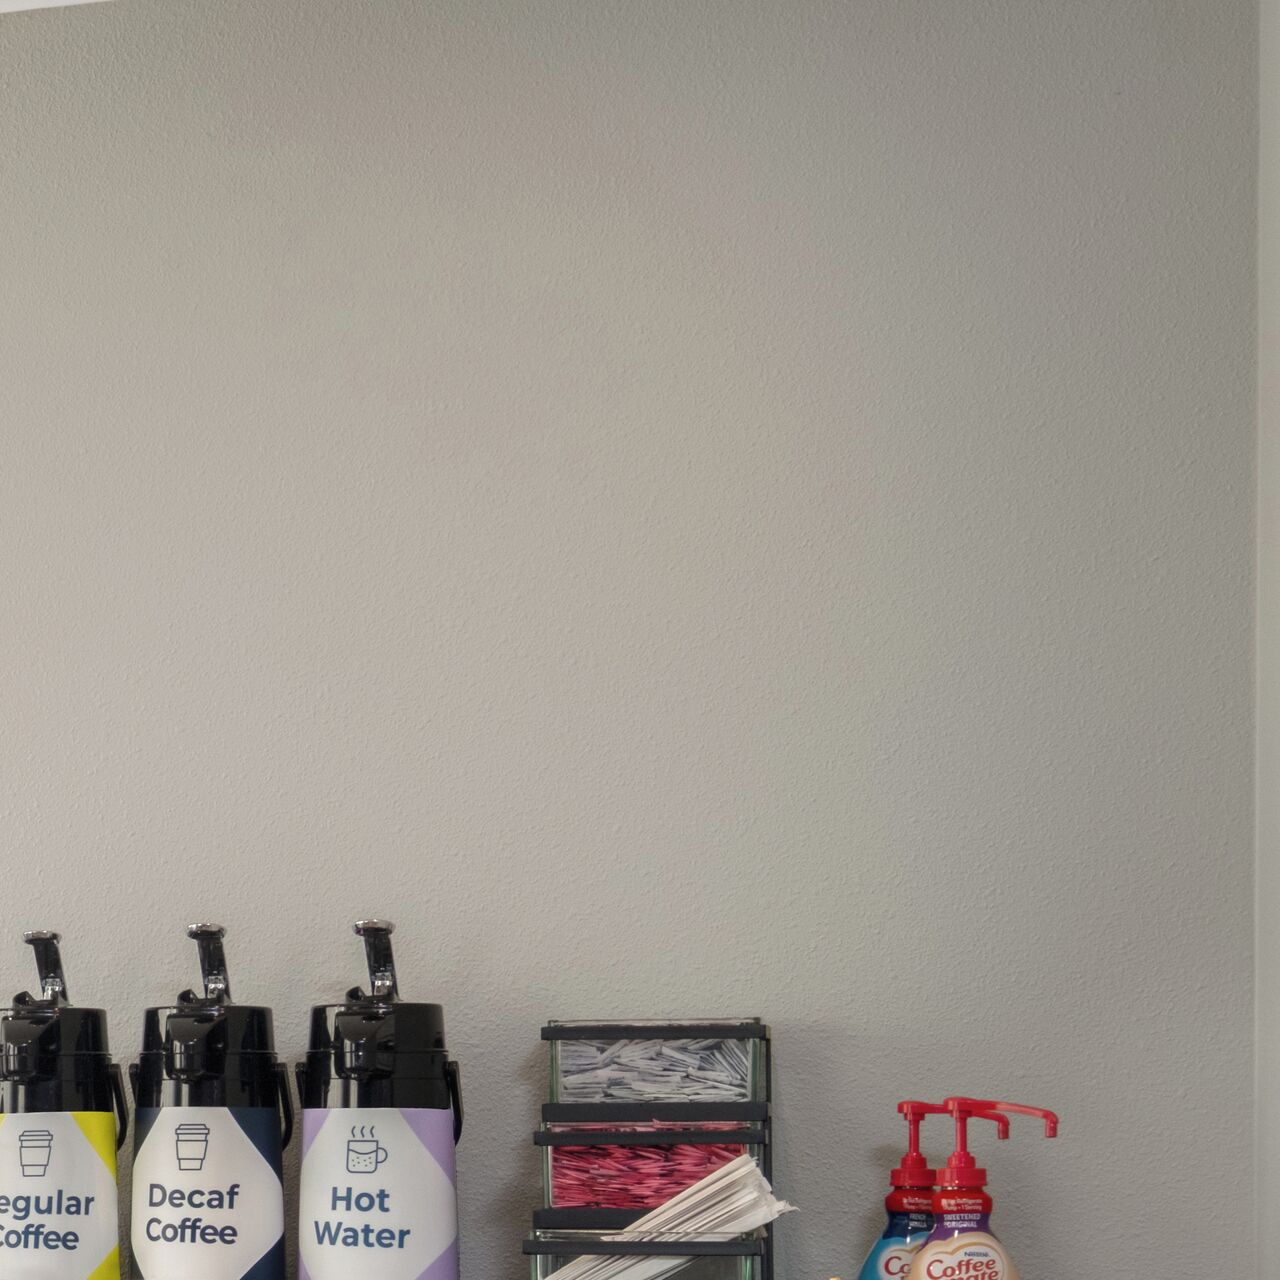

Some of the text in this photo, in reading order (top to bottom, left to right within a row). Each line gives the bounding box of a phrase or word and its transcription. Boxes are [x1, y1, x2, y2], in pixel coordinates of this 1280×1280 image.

[148, 1183, 240, 1209] Decaf
[331, 1186, 390, 1212] Hot
[146, 1217, 238, 1245] Coffee
[314, 1220, 411, 1249] Water
[926, 1259, 996, 1280] Coffee
